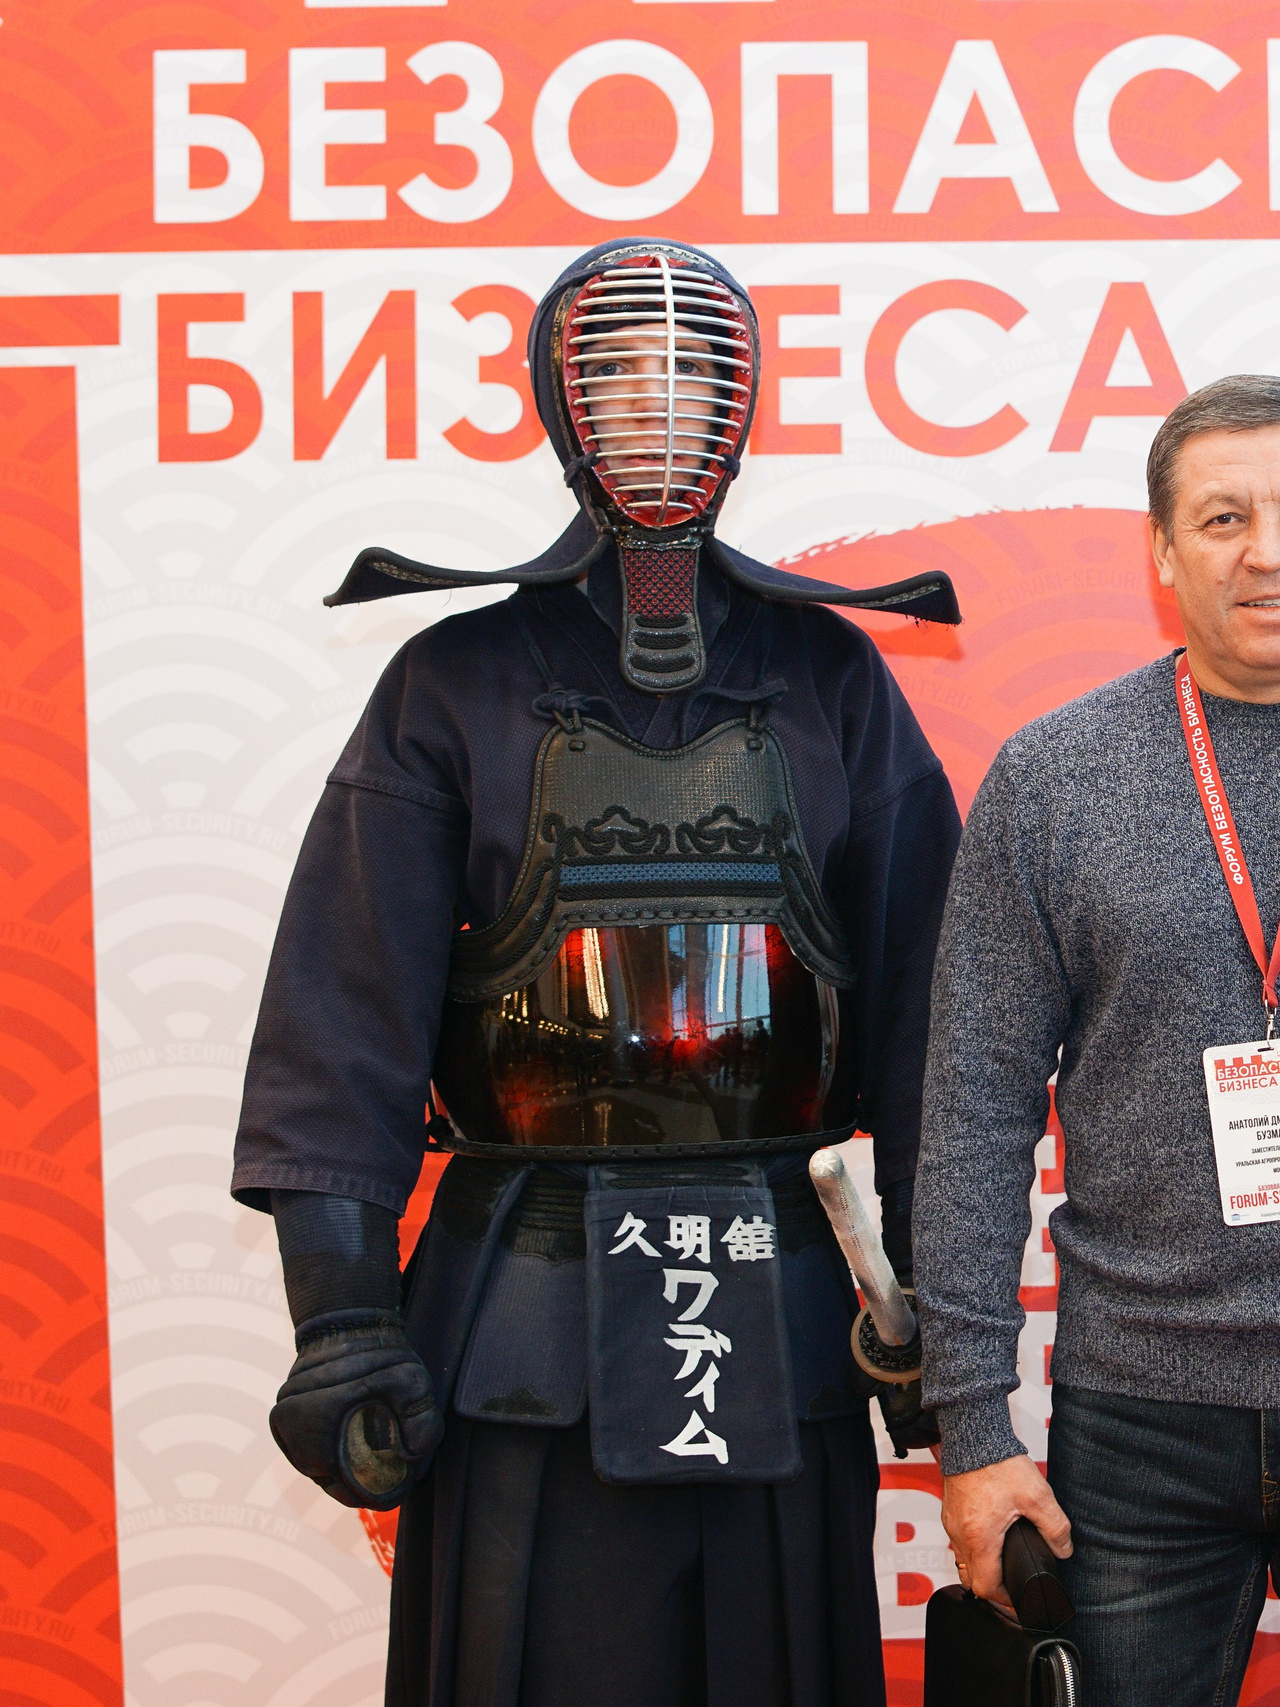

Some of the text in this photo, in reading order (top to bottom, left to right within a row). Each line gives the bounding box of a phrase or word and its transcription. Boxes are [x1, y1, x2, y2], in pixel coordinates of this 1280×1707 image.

[155, 278, 1188, 465] БИЗЕСА
[1181, 673, 1244, 885] ФОРУМ БЕЗОПАСНОСТЬ БИЗНЕСА
[96, 812, 288, 851] ORUM-SECURITY.RU
[1219, 1076, 1278, 1093] БИЗНЕСА
[1228, 1115, 1270, 1131] АНАТОЛИЙ
[1235, 1158, 1261, 1168] УРАЛЬСКАЯ
[1258, 1182, 1280, 1192] БАЗОВАЯ
